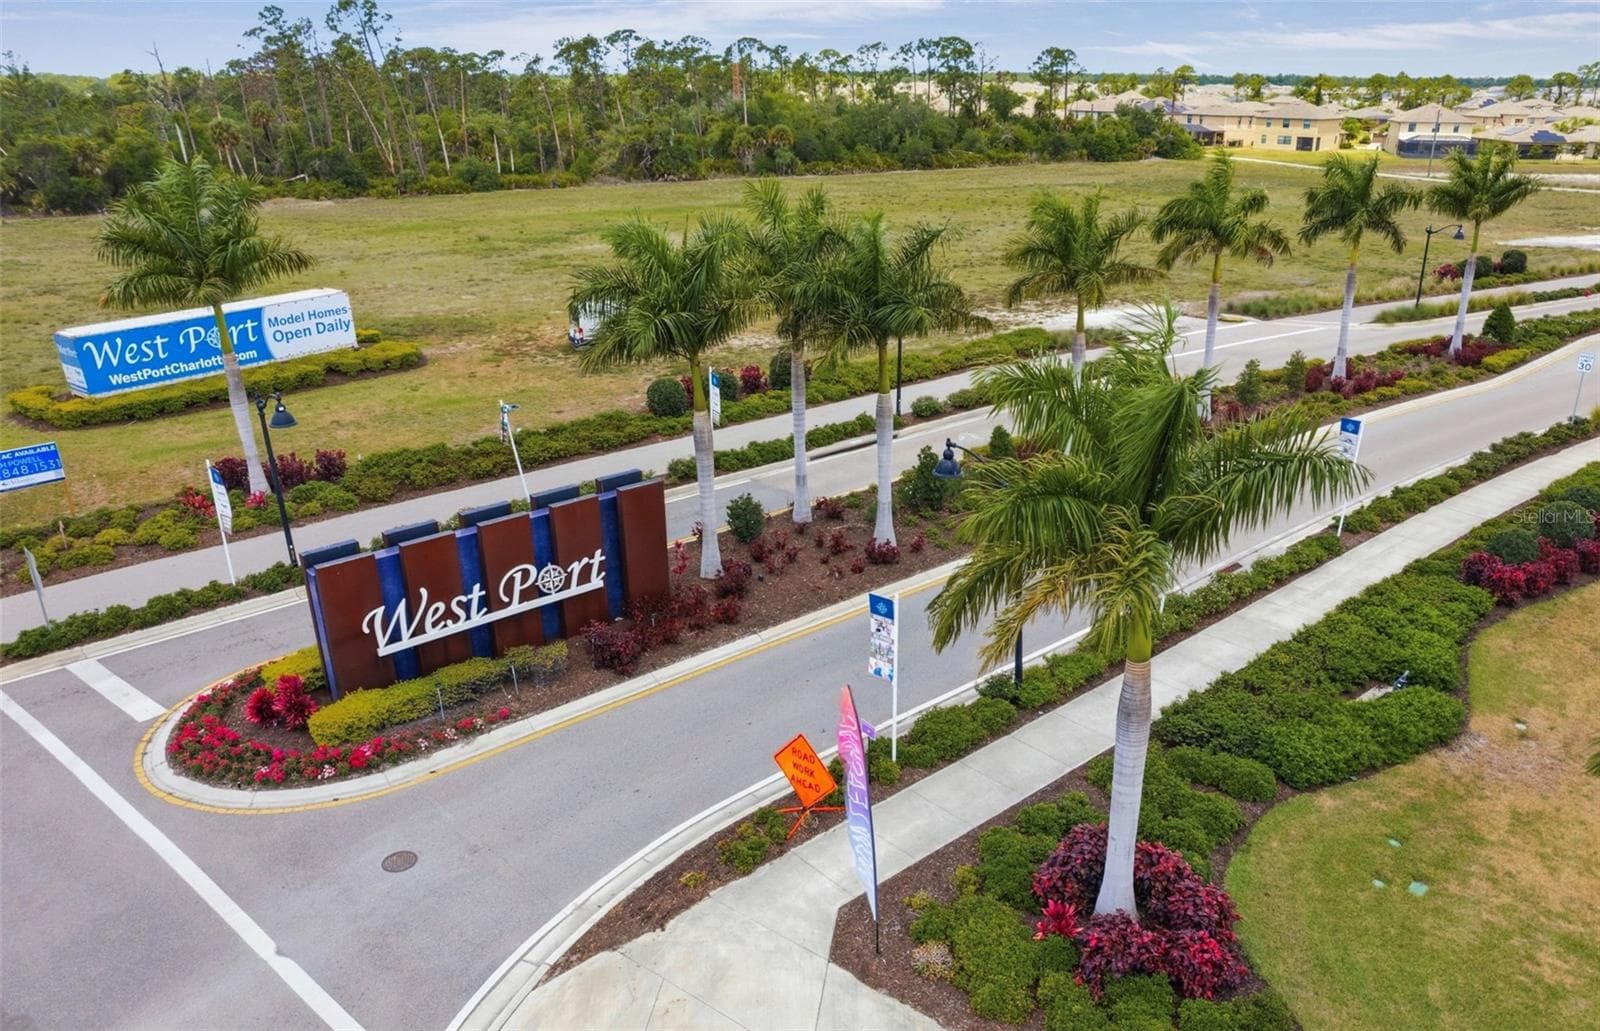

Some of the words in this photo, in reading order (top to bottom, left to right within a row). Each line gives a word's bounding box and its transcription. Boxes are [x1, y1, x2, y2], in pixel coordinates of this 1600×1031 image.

[268, 309, 306, 328] Model
[308, 305, 348, 324] Homes
[272, 325, 313, 344] Open
[316, 318, 352, 340] Daily
[83, 335, 169, 370] West
[1579, 362, 1592, 371] 30
[14, 445, 56, 458] AVAILABLE
[362, 583, 488, 648] West
[499, 548, 606, 609] Port
[791, 747, 816, 765] ROAD
[791, 760, 816, 778] WORK
[790, 774, 821, 793] AHEAD
